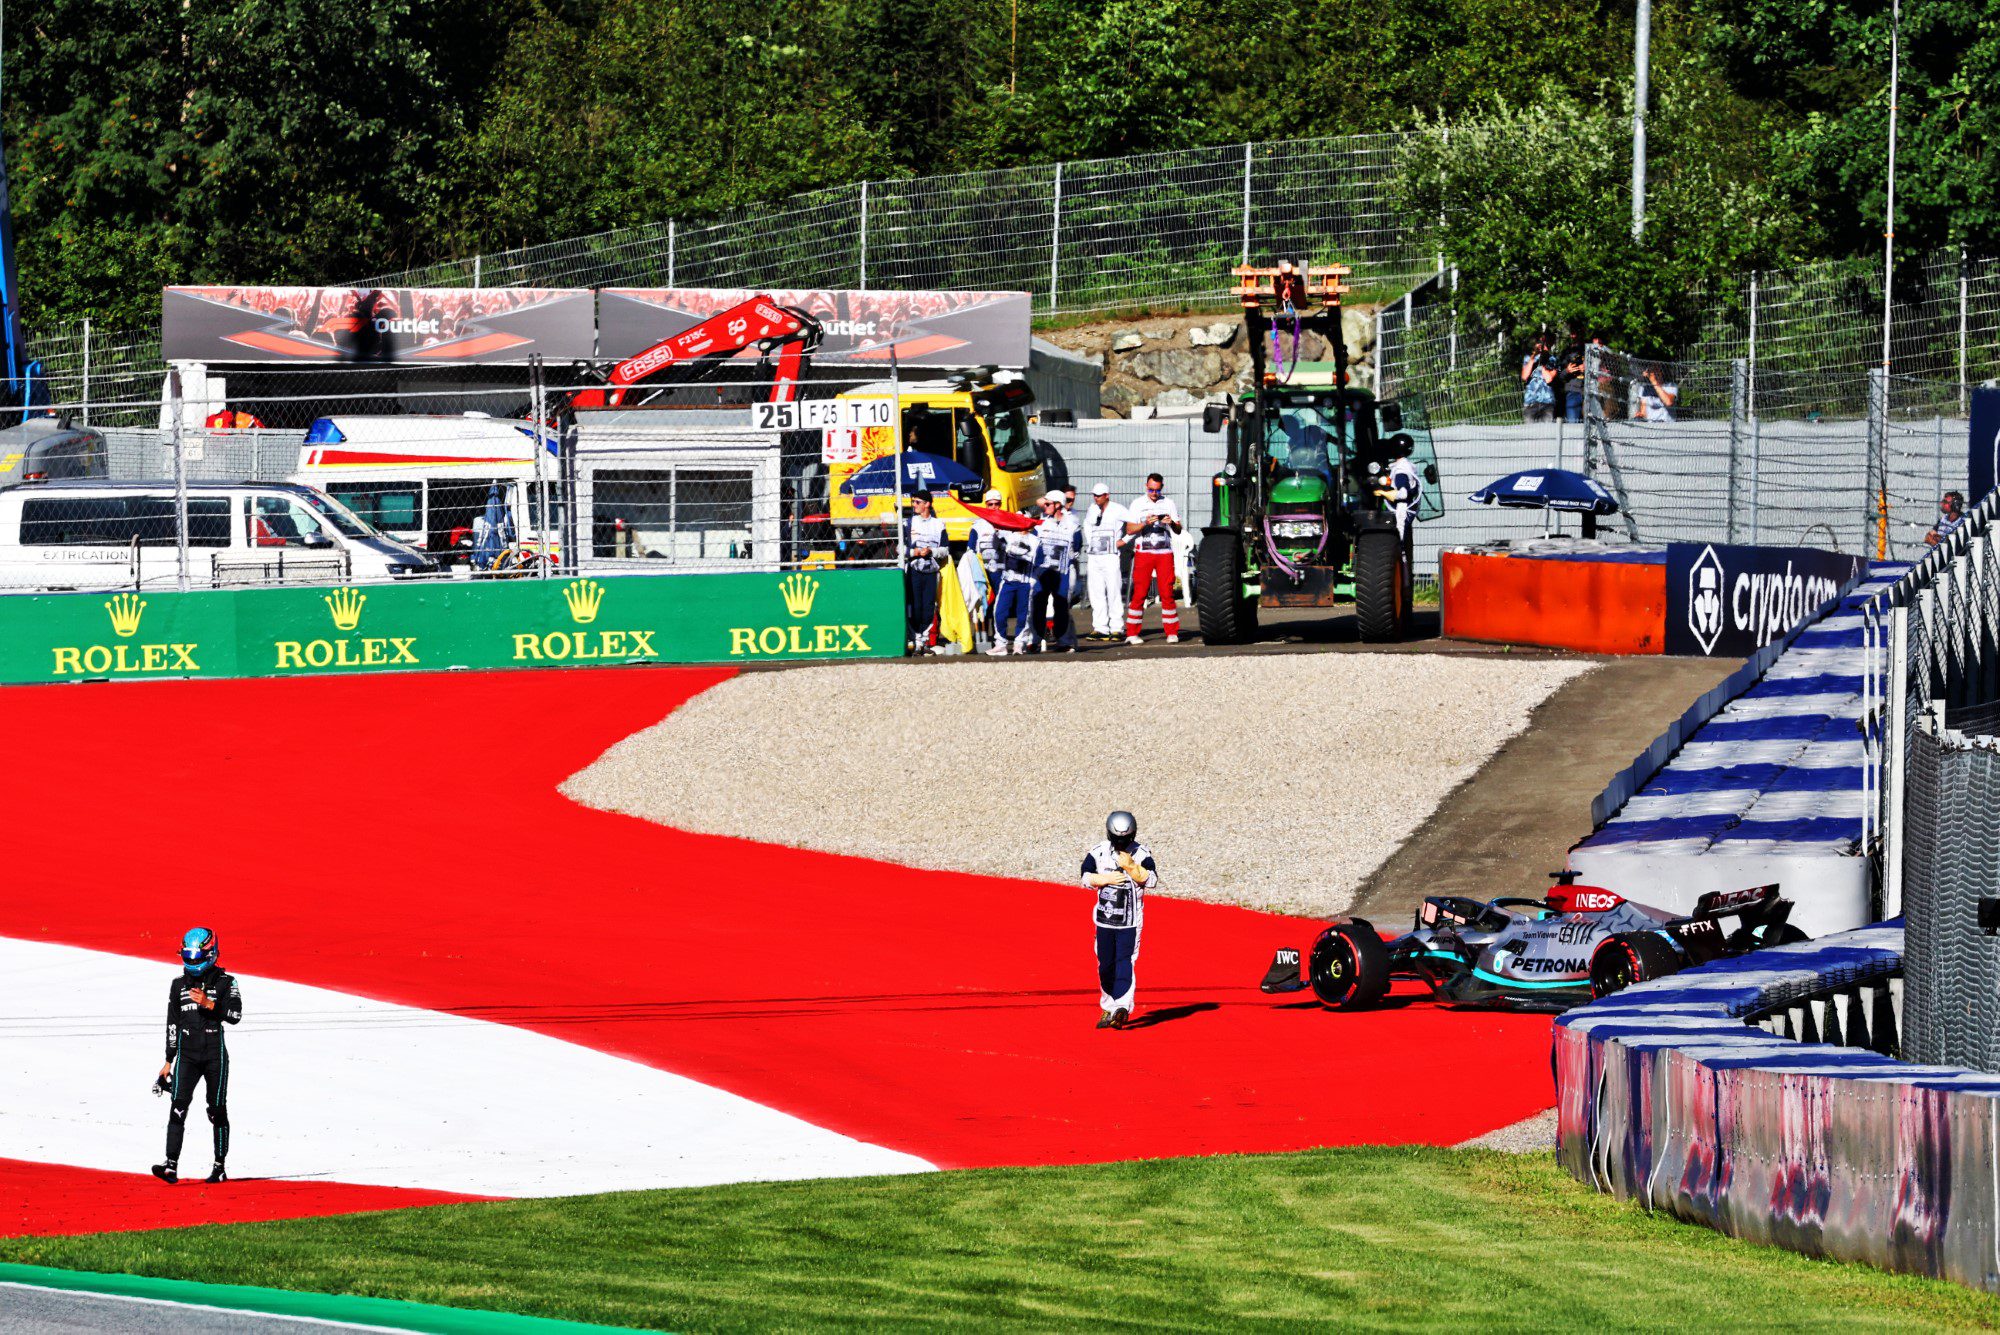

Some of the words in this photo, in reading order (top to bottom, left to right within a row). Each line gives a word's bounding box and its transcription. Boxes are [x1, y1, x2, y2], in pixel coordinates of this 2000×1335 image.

[374, 318, 439, 334] Outlet
[623, 348, 669, 379] FASSI
[760, 404, 792, 428] 25
[809, 405, 817, 424] F
[822, 404, 837, 424] 25
[851, 404, 862, 423] T
[869, 403, 889, 422] 10
[43, 551, 129, 560] EXTRICATION
[1732, 560, 1838, 648] cryptocom
[512, 630, 659, 660] ROLEX
[729, 624, 872, 654] ROLEX
[52, 643, 201, 674] ROLEX
[275, 637, 420, 668] ROLEX
[1575, 893, 1617, 908] INEOS
[1690, 919, 1714, 934] FTX
[1276, 950, 1299, 965] IWC
[1511, 957, 1591, 973] PETRONA
[168, 1023, 177, 1048] INEOS
